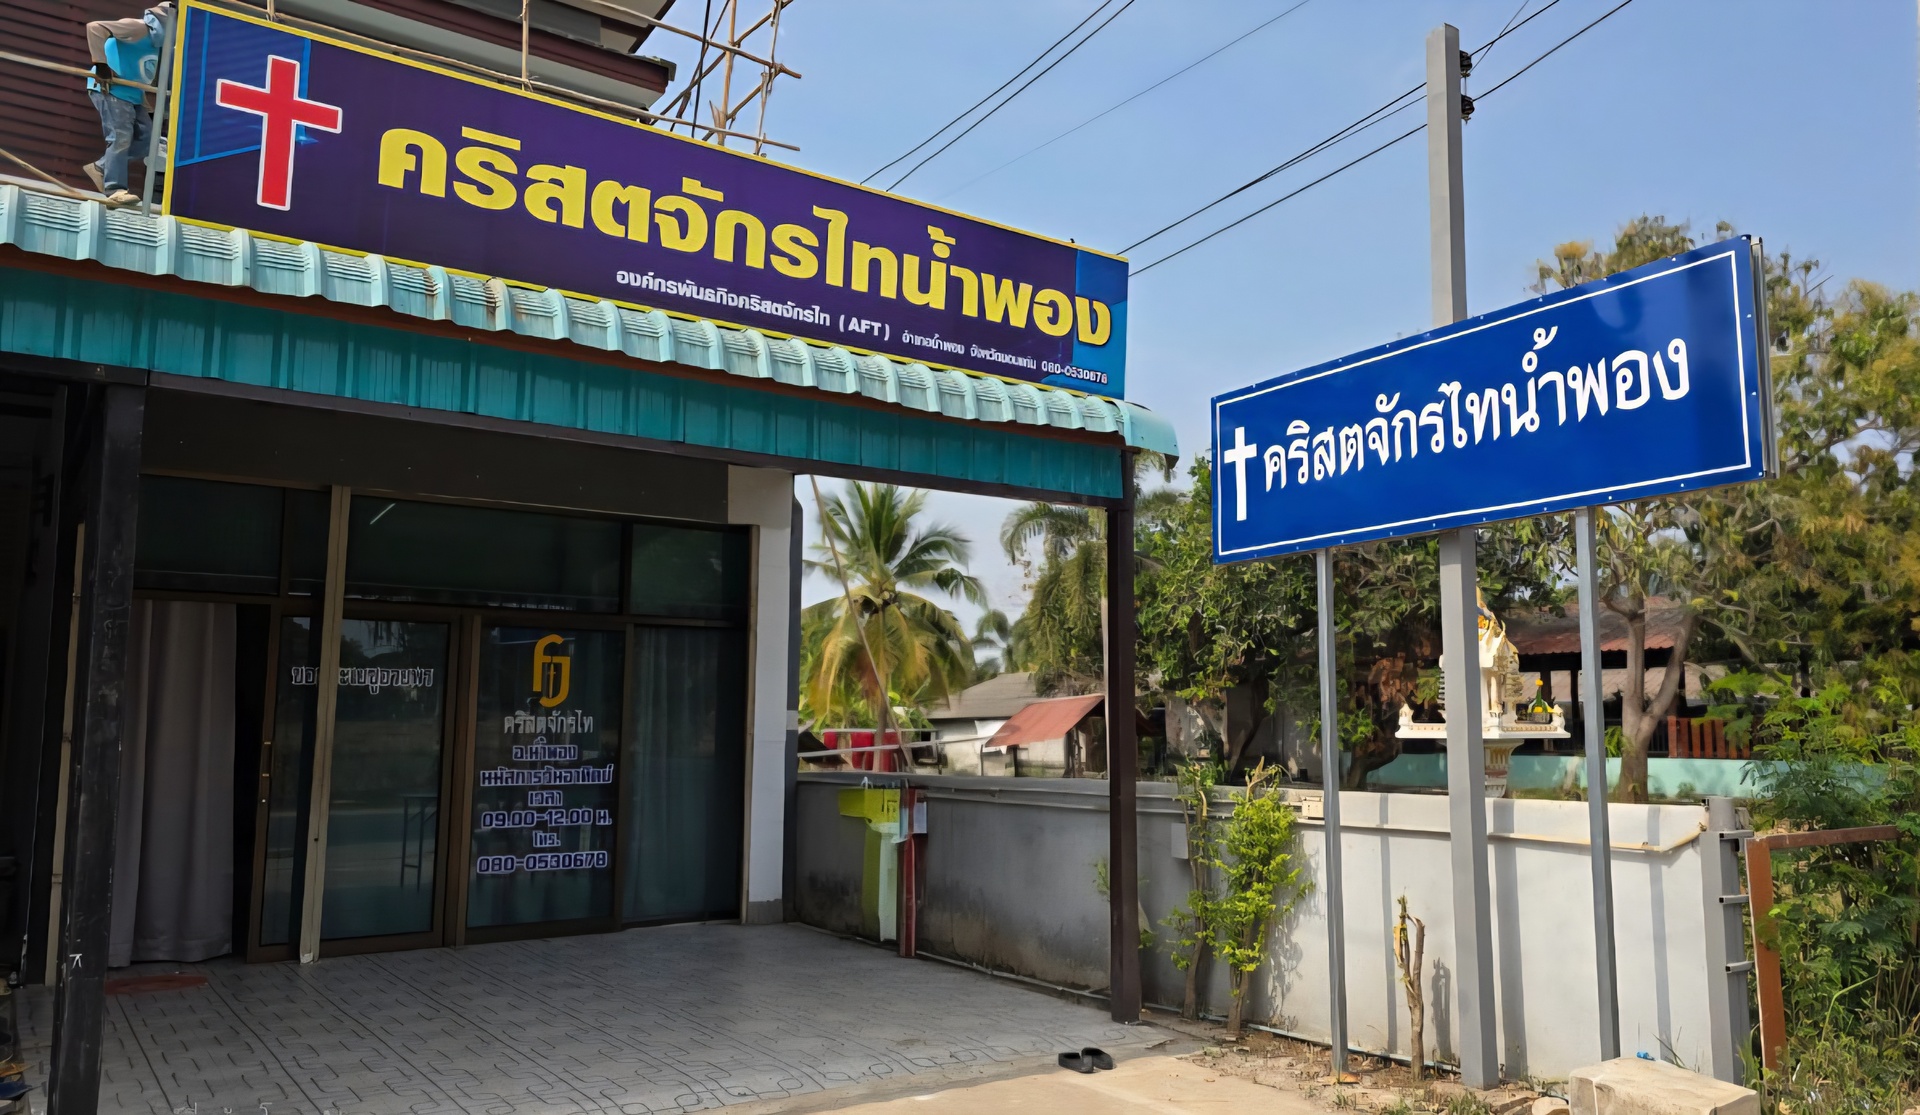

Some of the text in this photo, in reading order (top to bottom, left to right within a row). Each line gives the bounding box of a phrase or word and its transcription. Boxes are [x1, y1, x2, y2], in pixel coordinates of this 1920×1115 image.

[378, 128, 1111, 345] คริสตจักรไทน้ำพอง
[616, 270, 831, 327] องค์กรพันธกิจคริสตจักรไท
[1263, 326, 1690, 492] คริสตจักรไทน้ำพอง
[504, 710, 594, 734] คริสตจักรไท
[528, 790, 563, 806] เวลา
[481, 808, 613, 829] 09.00-12.00 น.
[532, 830, 561, 847] โทร.
[477, 851, 608, 874] 080-0530678
